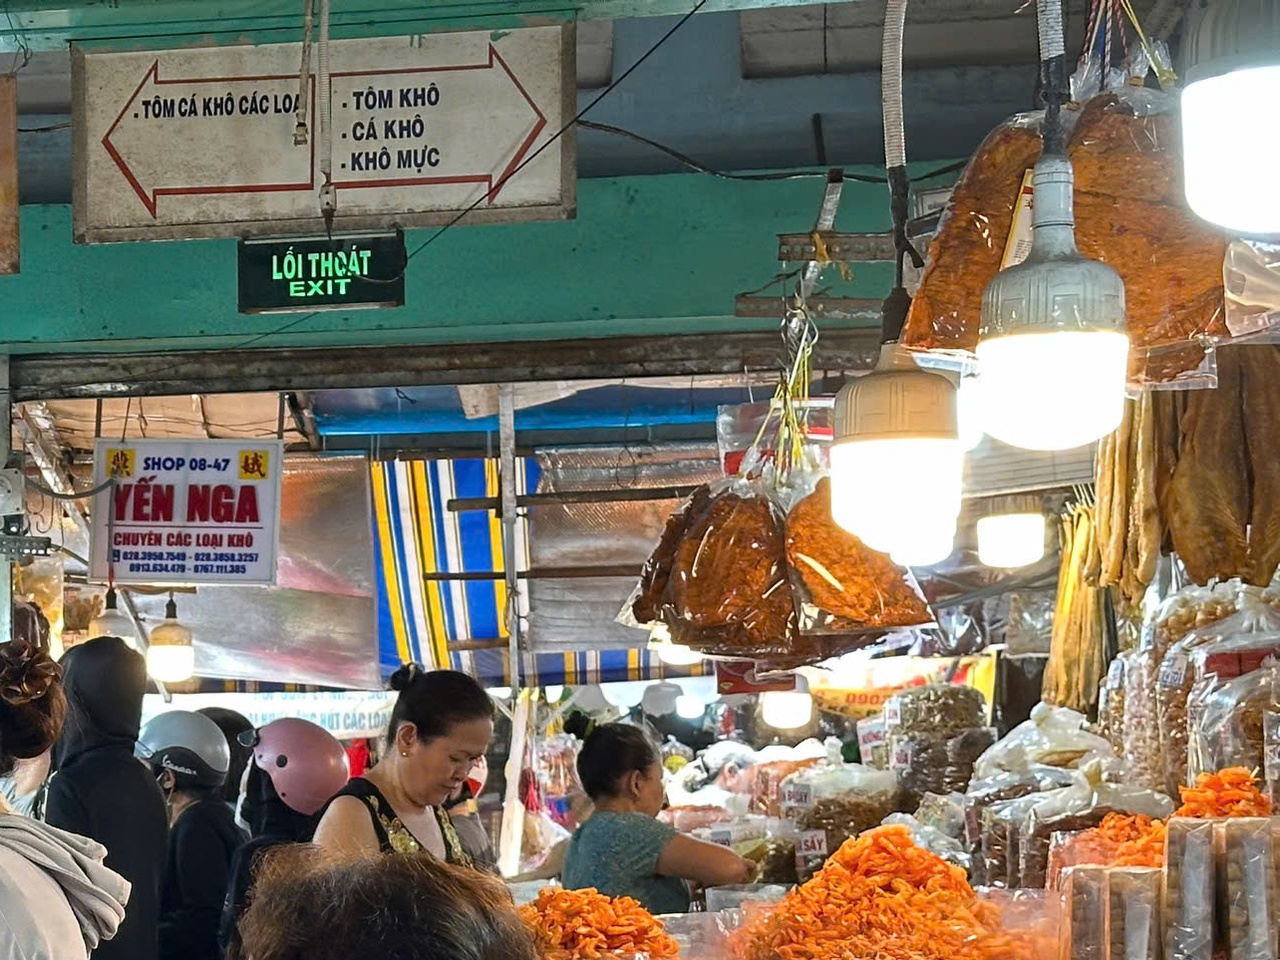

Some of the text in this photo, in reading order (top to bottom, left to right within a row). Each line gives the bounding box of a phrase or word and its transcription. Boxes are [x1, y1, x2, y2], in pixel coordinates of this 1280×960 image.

[142, 95, 175, 119] TÔM
[178, 93, 198, 117] CÁ
[202, 92, 235, 117] KHÔ
[238, 91, 270, 115] CÁC
[352, 82, 440, 110] TÔM KHÔ
[352, 113, 425, 141] CÁ KHÔ
[351, 144, 440, 174] KHÔ MỰC
[272, 244, 372, 280] LỐI THOÁT
[289, 278, 352, 297] EXIT
[143, 457, 230, 472] SHOP 08-47
[114, 475, 260, 524] YẾN NGA
[113, 530, 254, 550] CHUYÊN CÁC LOẠI KHÔ
